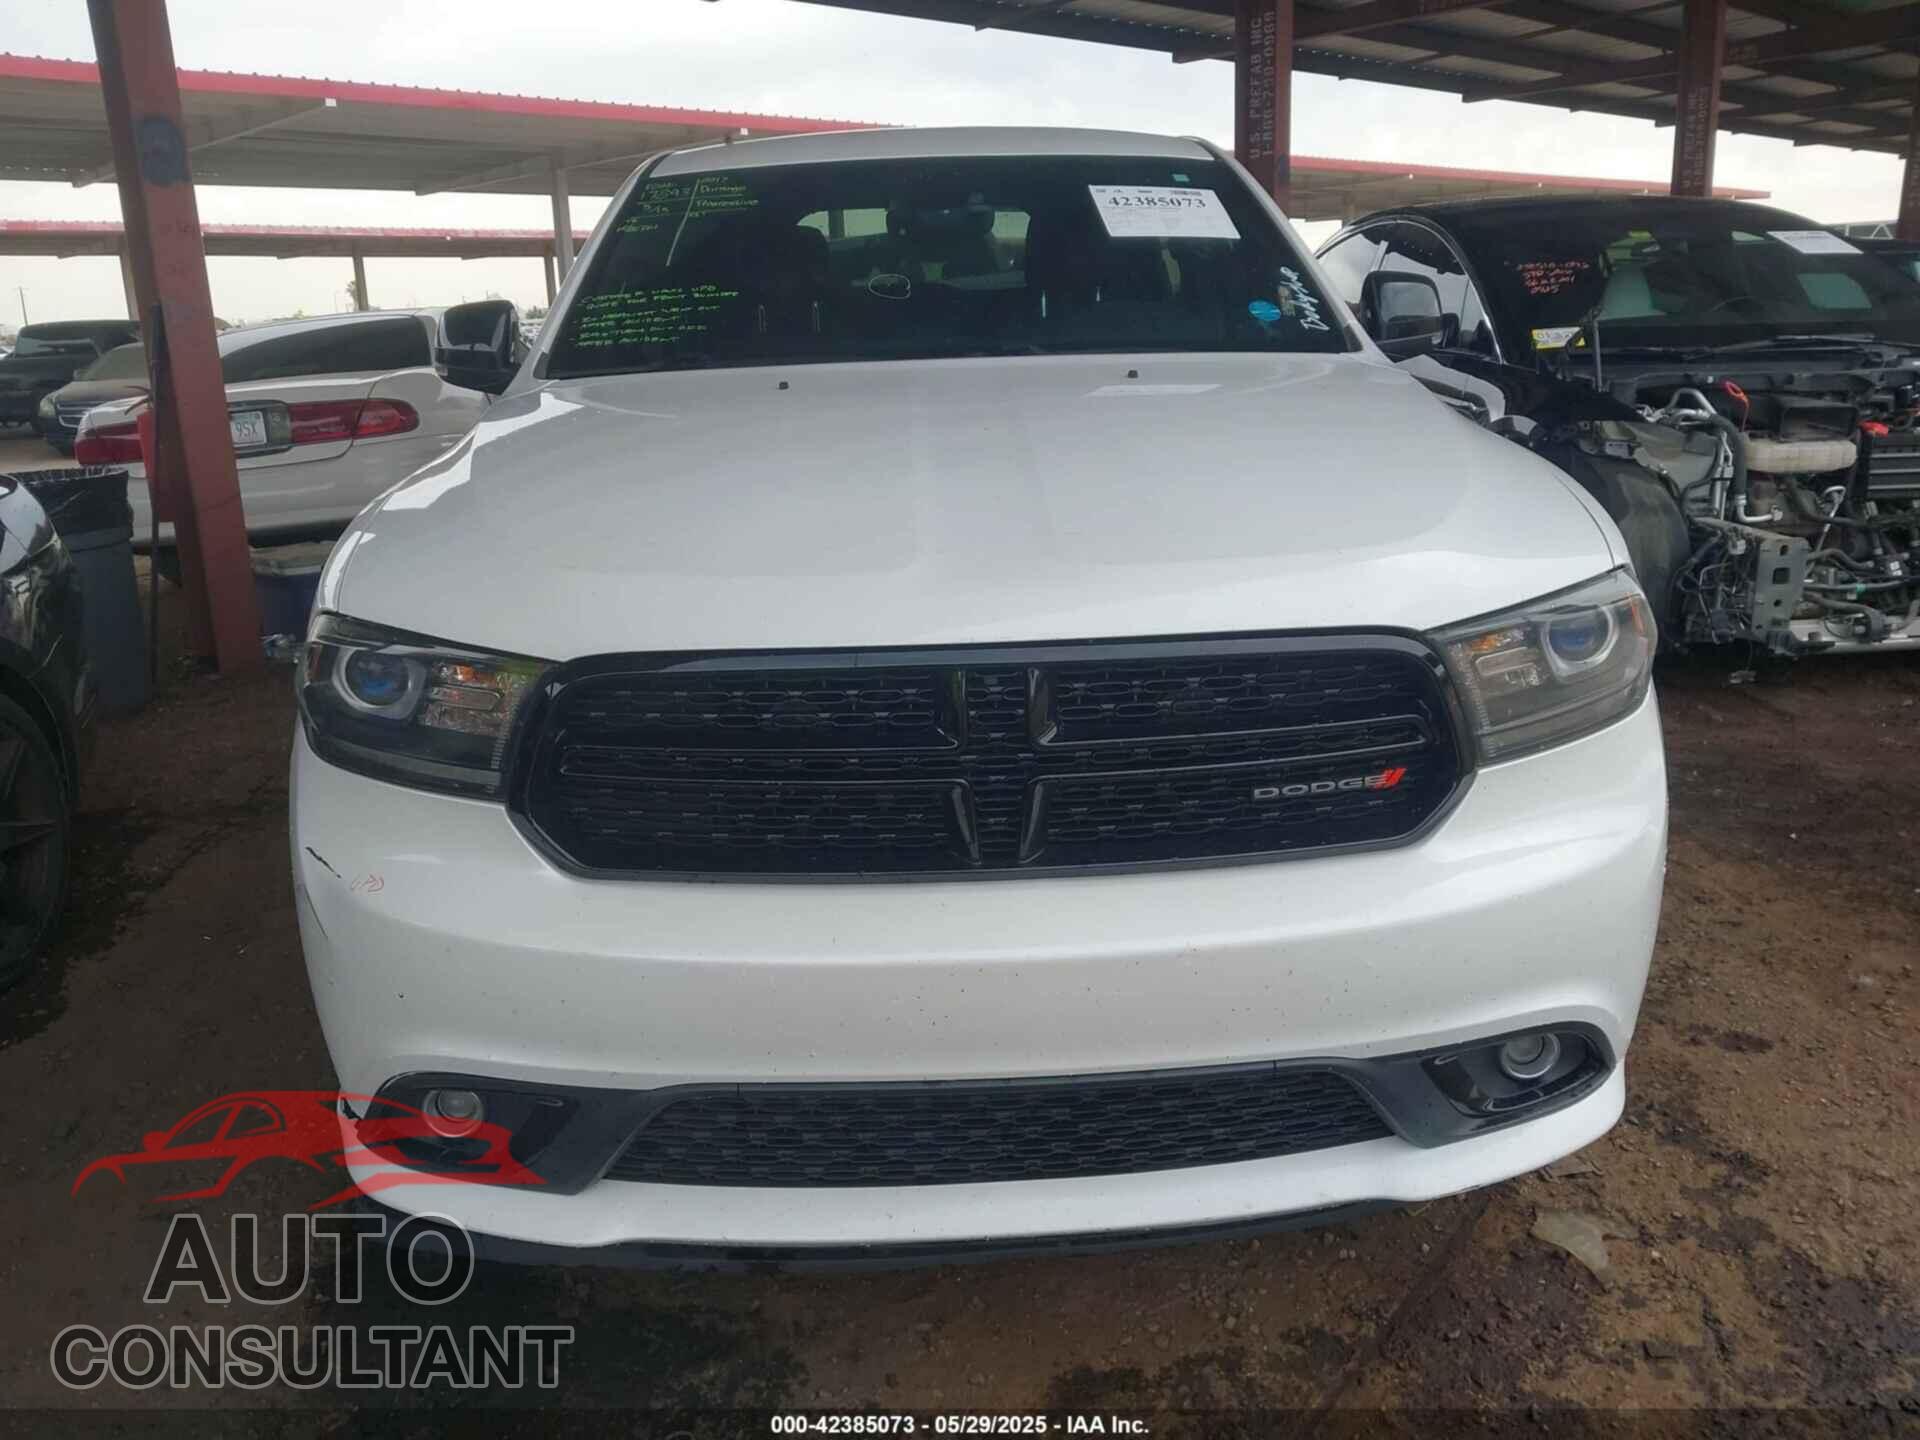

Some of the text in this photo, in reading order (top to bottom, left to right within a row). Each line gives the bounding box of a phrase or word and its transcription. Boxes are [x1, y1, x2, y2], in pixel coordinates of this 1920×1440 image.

[1248, 53, 1262, 119] PREFAB
[1108, 196, 1207, 209] 42385073
[1254, 775, 1387, 800] DODGE
